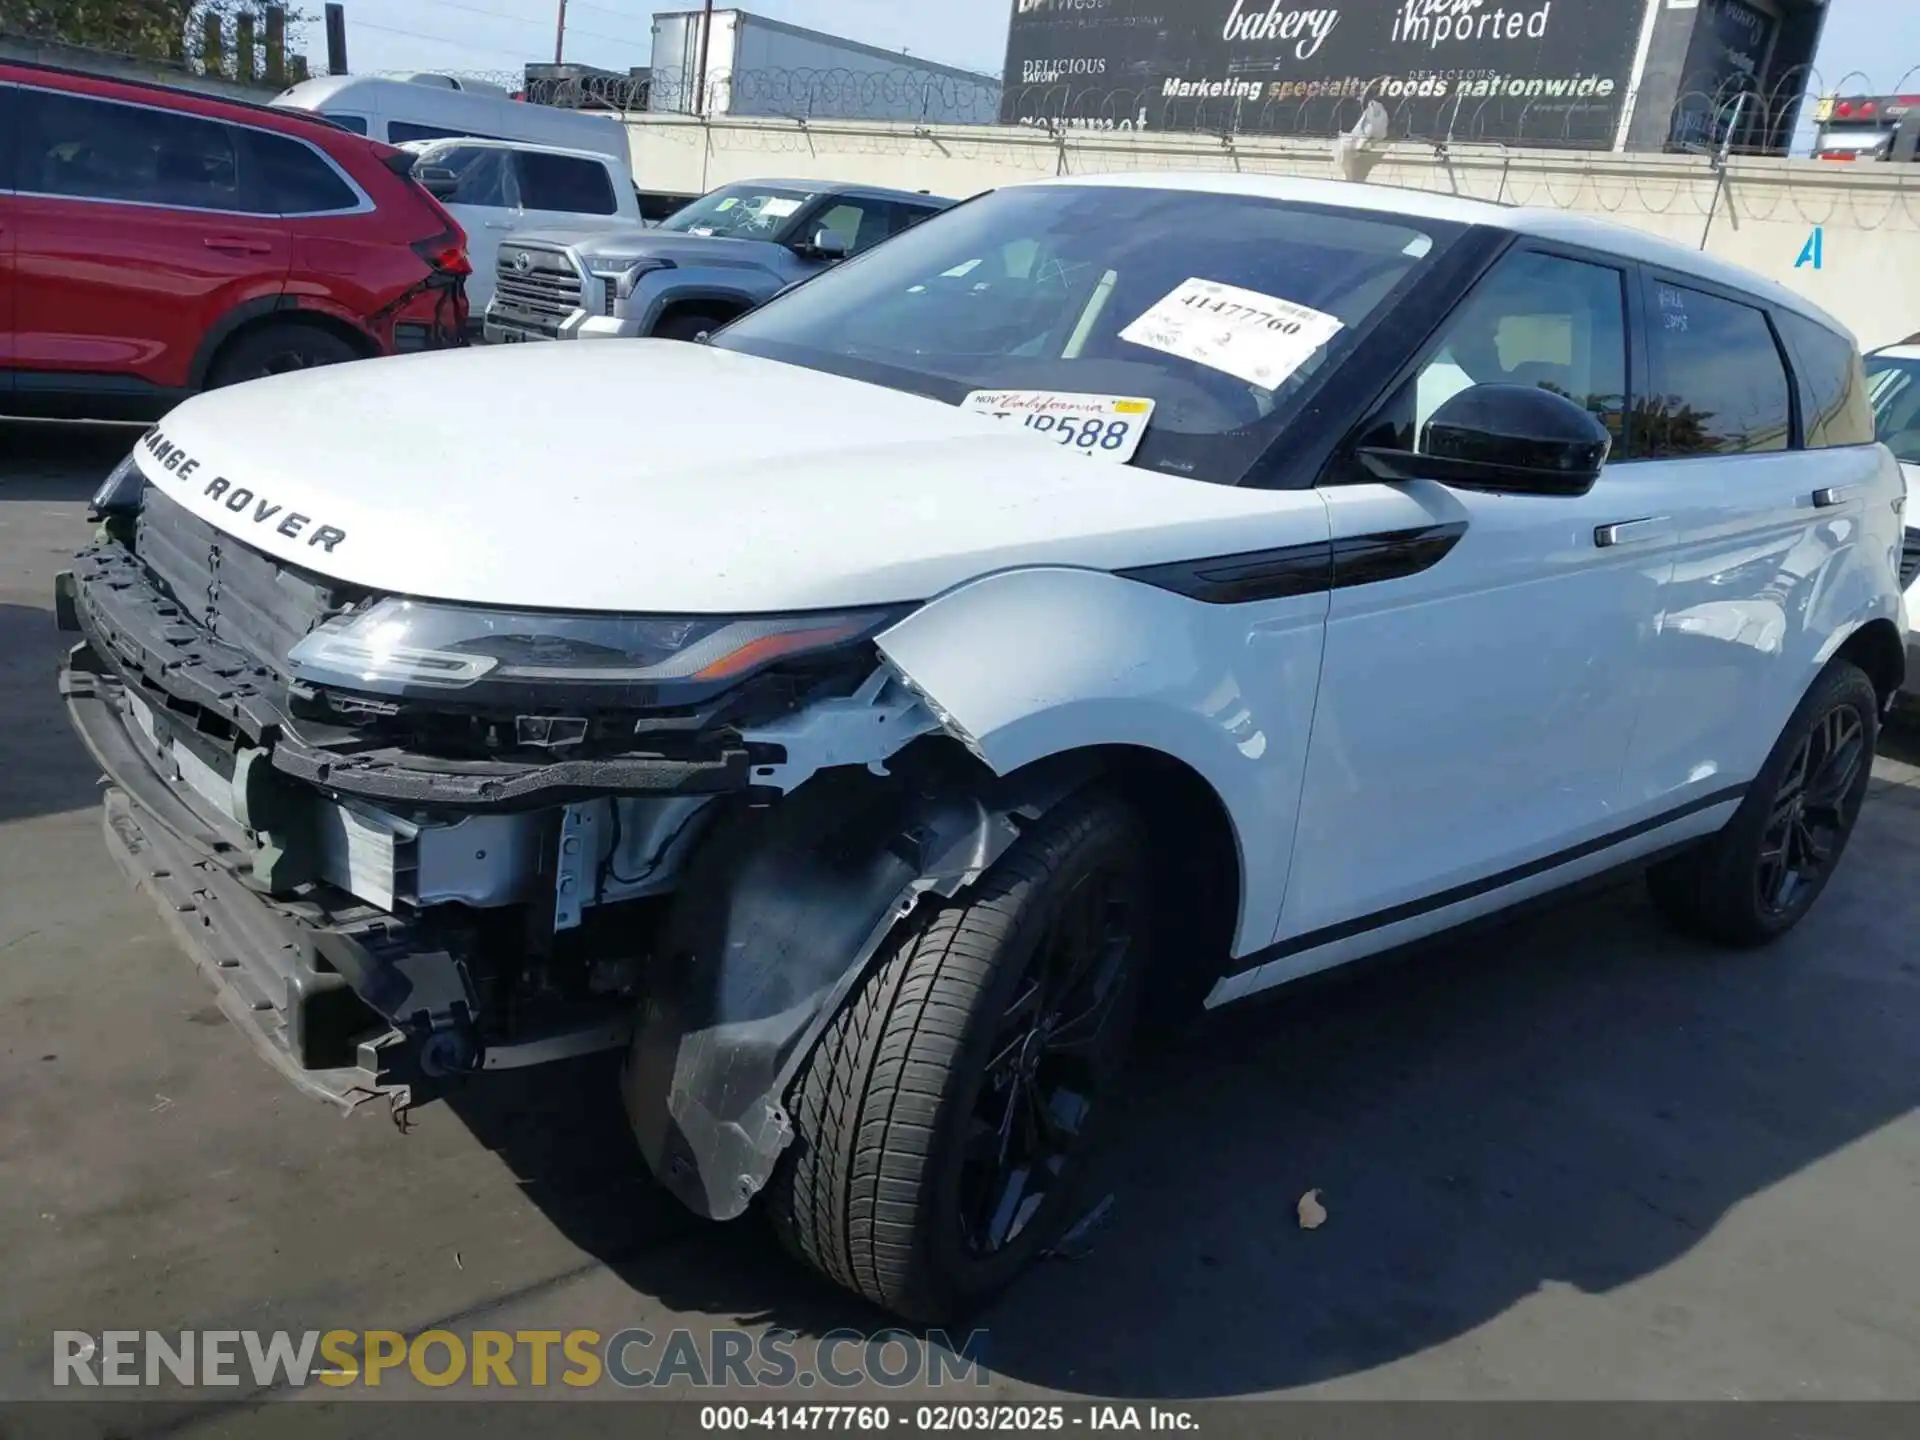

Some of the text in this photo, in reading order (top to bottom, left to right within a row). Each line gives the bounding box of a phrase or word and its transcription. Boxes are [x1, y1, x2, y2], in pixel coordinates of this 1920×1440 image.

[1222, 0, 1341, 60] bakery
[1391, 2, 1550, 48] imported
[1022, 71, 1059, 83] SAVORY
[1023, 58, 1106, 74] DELICIOUS
[1408, 69, 1496, 80] DELICIOUS
[1161, 73, 1614, 100] Marketing specialty foods nationwide
[1794, 226, 1823, 270] A
[1180, 294, 1301, 335] 41477760
[1000, 395, 1104, 413] California
[143, 424, 346, 553] RANGE ROVER
